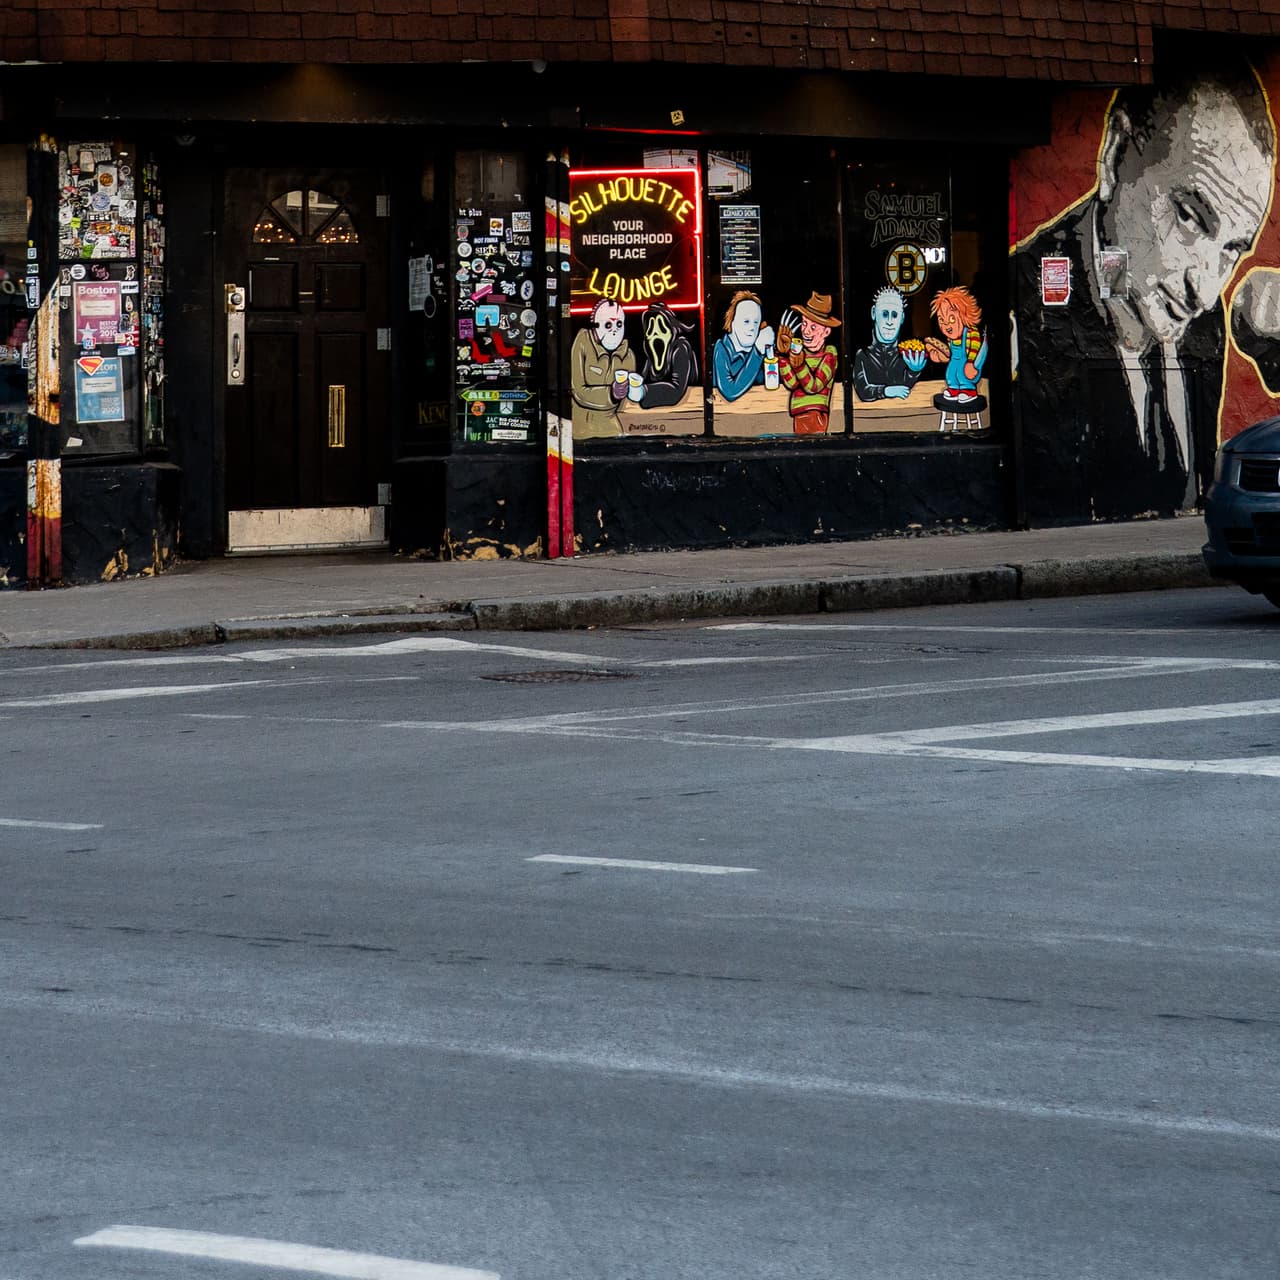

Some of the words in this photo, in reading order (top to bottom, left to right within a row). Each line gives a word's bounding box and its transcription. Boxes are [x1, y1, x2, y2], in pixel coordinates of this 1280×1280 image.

[568, 176, 696, 224] SILHOUETTE
[864, 190, 949, 221] SAMUEL
[582, 233, 673, 246] NEIGHBORHOOD
[612, 220, 644, 231] YOUR
[870, 217, 942, 248] ADAMS
[609, 248, 647, 259] PLACE
[897, 250, 917, 285] B
[78, 286, 117, 295] Boston
[588, 264, 678, 303] LOUNGE
